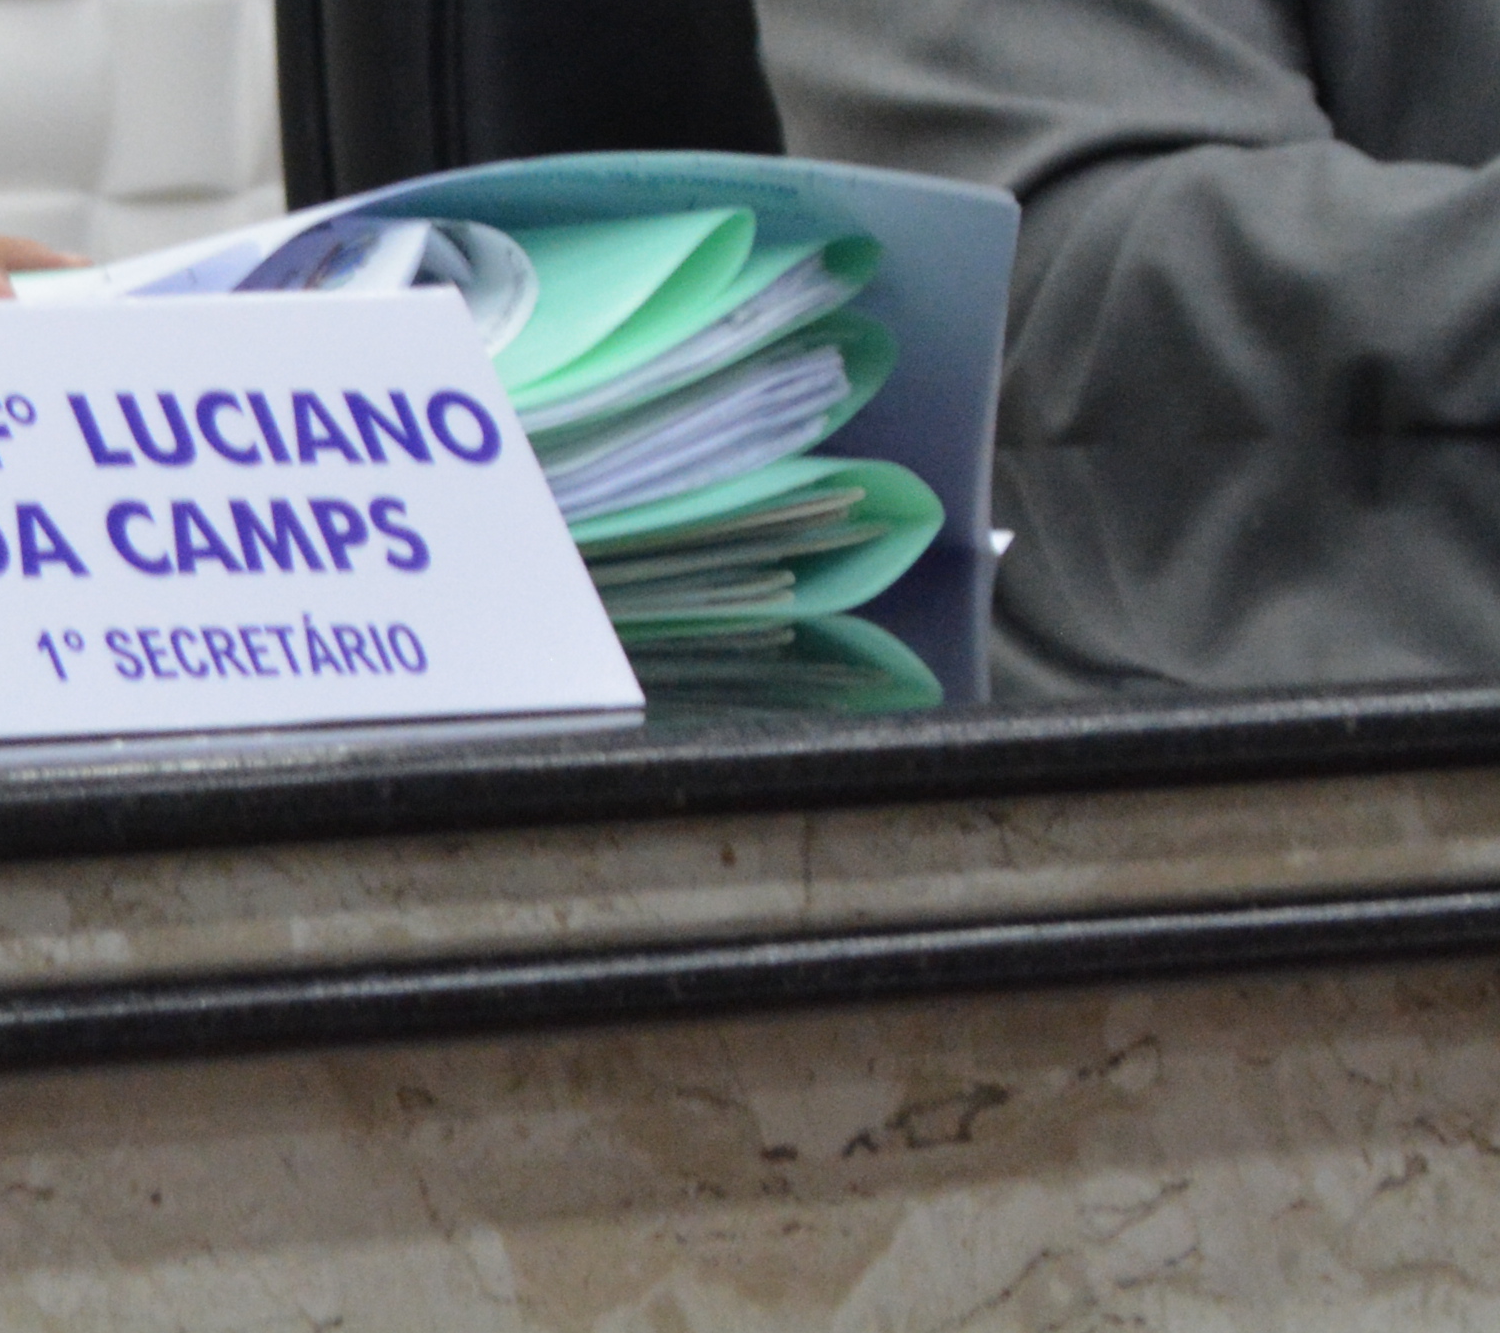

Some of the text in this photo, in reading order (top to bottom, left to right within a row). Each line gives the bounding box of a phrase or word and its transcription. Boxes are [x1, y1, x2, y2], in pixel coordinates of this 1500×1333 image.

[66, 389, 502, 468] LUCIANO
[105, 496, 431, 575] CAMPS
[103, 611, 429, 681] SECRETÁRIO
